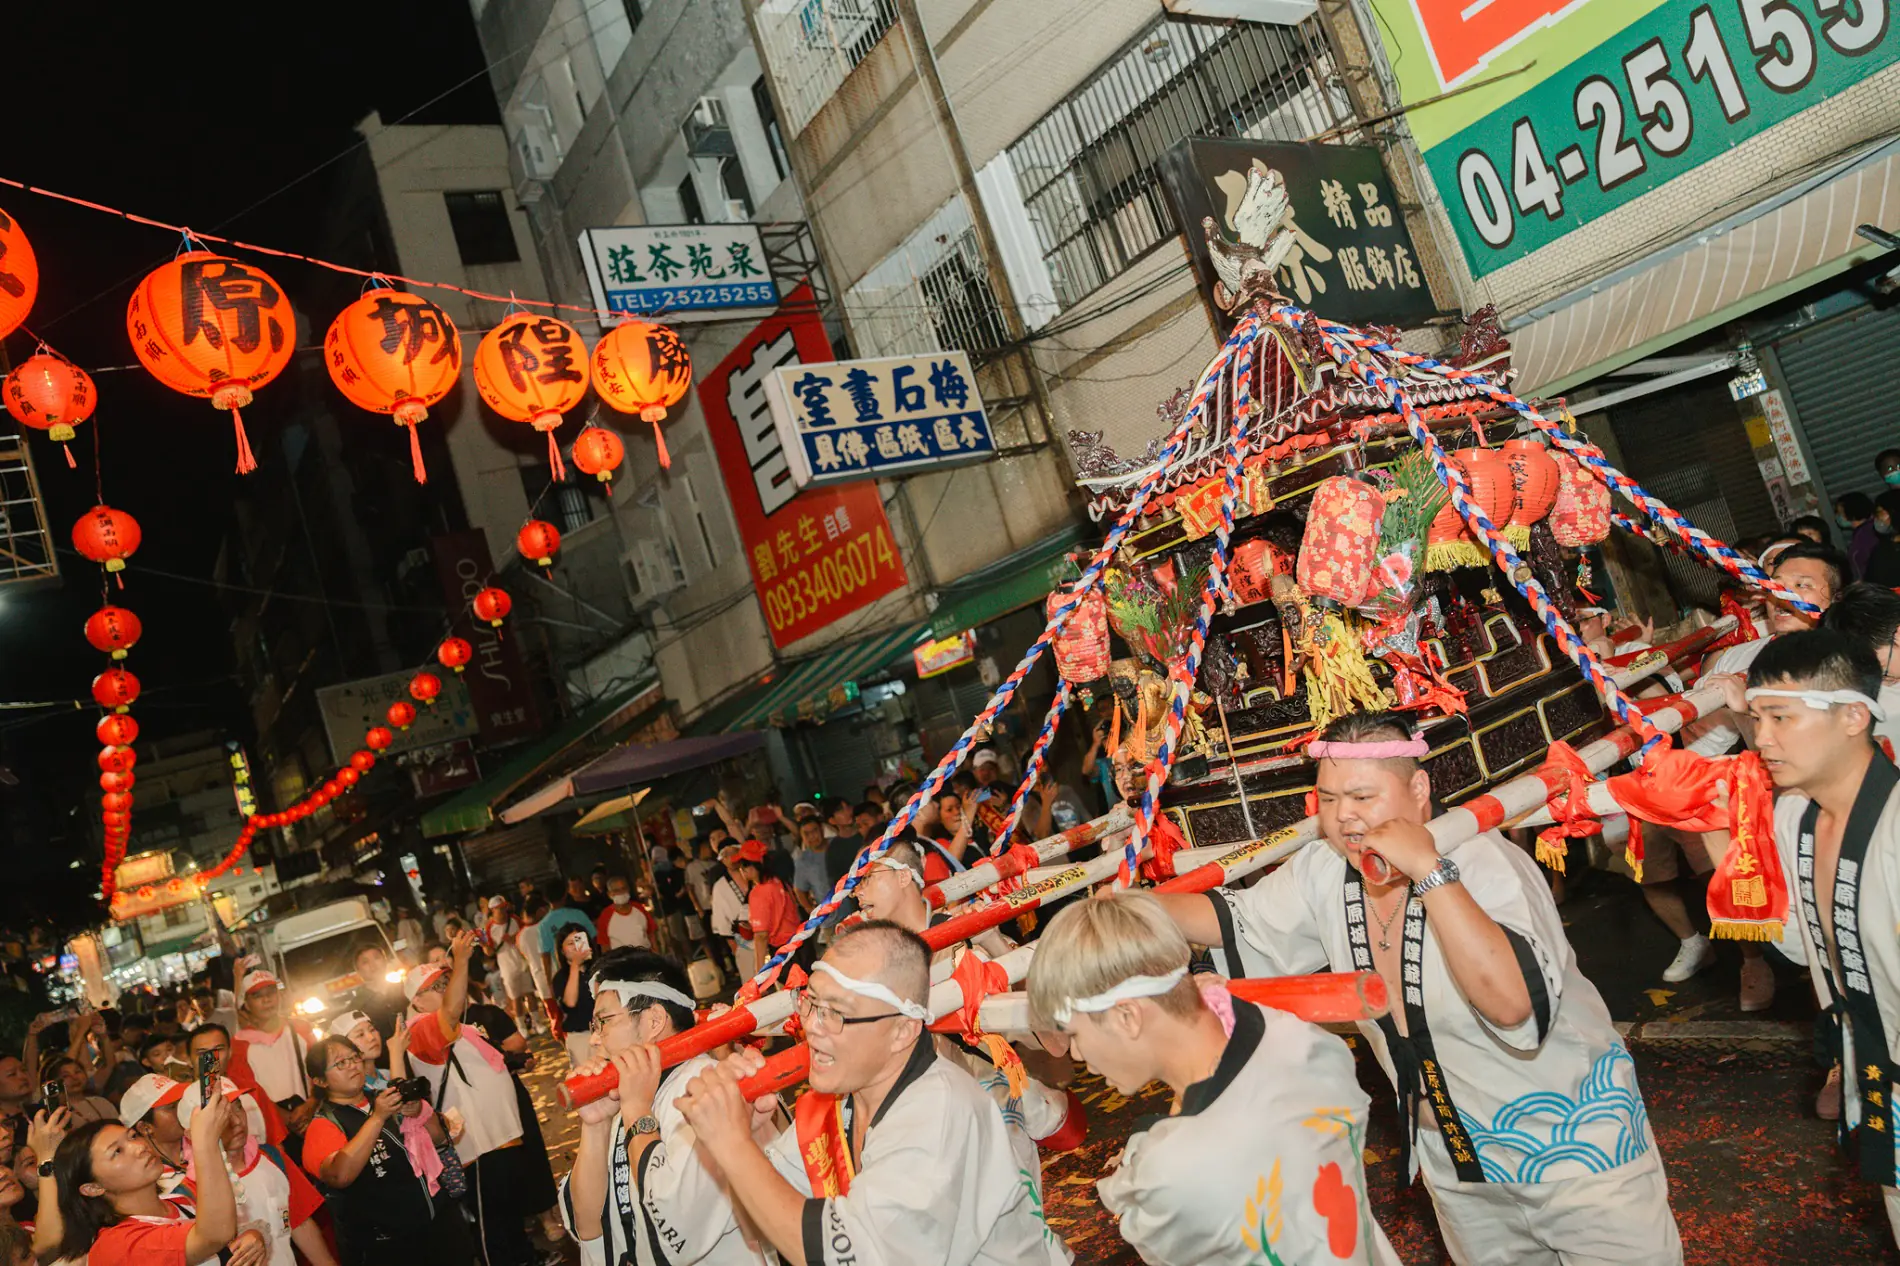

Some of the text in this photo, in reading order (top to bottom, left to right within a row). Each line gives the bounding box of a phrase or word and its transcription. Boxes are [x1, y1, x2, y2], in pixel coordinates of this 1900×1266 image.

[1320, 179, 1393, 230] 精品
[1337, 244, 1421, 291] 服飾店
[499, 318, 583, 393] 隍
[753, 514, 823, 583] 劉先生
[765, 525, 896, 631] 0933406074
[1344, 881, 1373, 973] 豐原城隍
